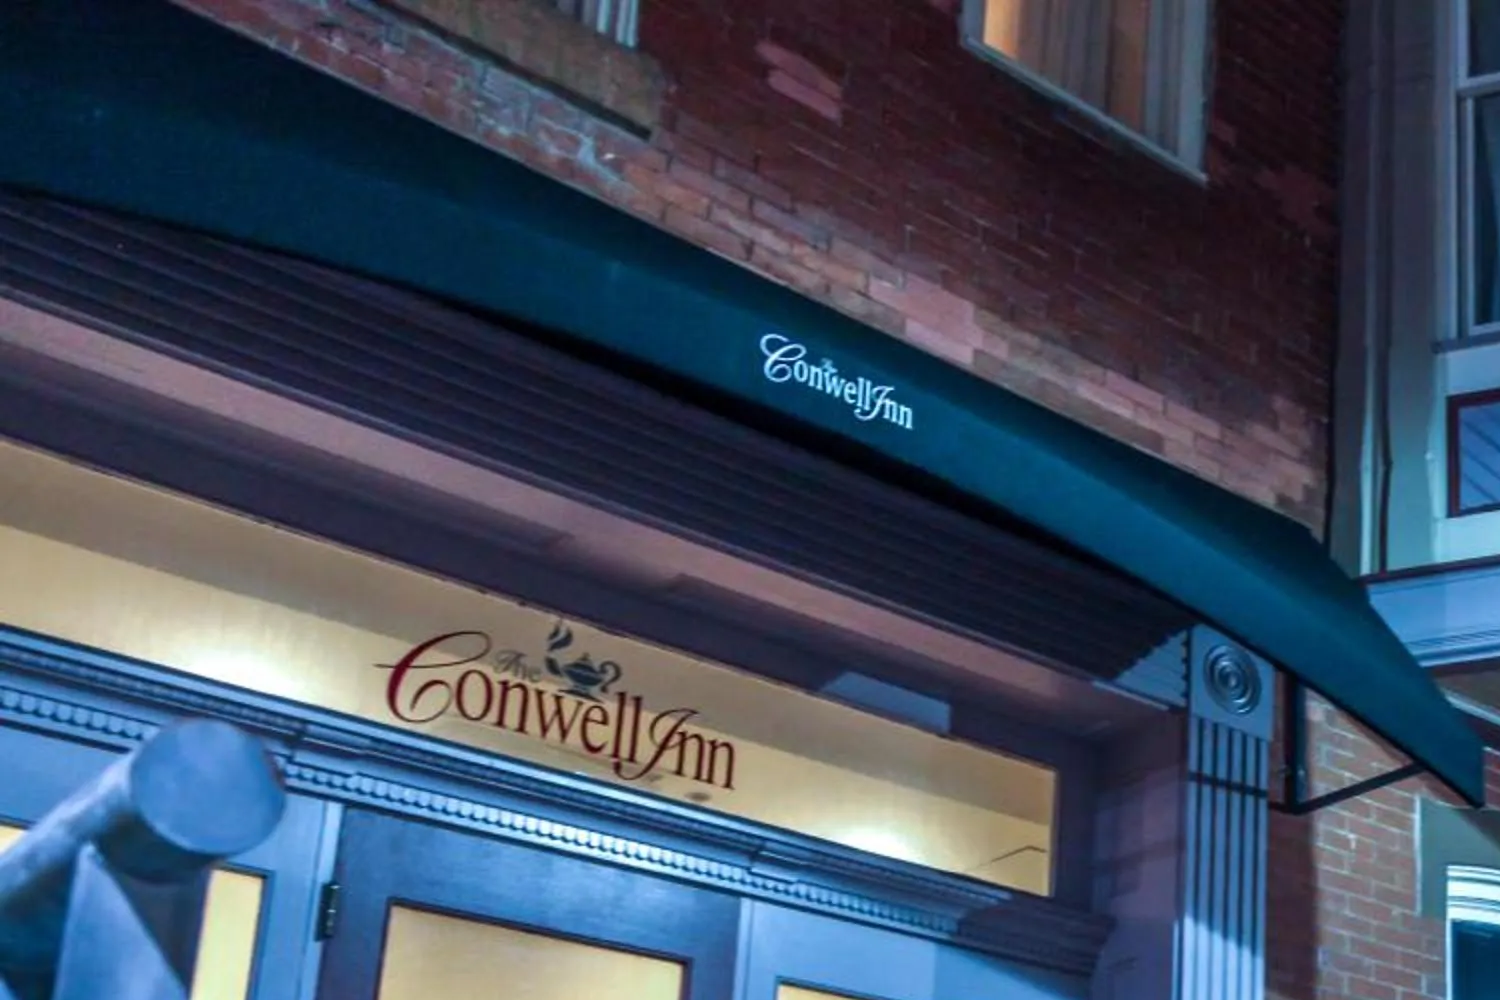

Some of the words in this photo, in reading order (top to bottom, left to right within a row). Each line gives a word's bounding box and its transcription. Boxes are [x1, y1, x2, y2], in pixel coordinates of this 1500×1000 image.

[759, 333, 873, 411] Conwell
[853, 385, 914, 430] Inn
[373, 630, 643, 764] Conwell
[612, 708, 736, 790] Inn
